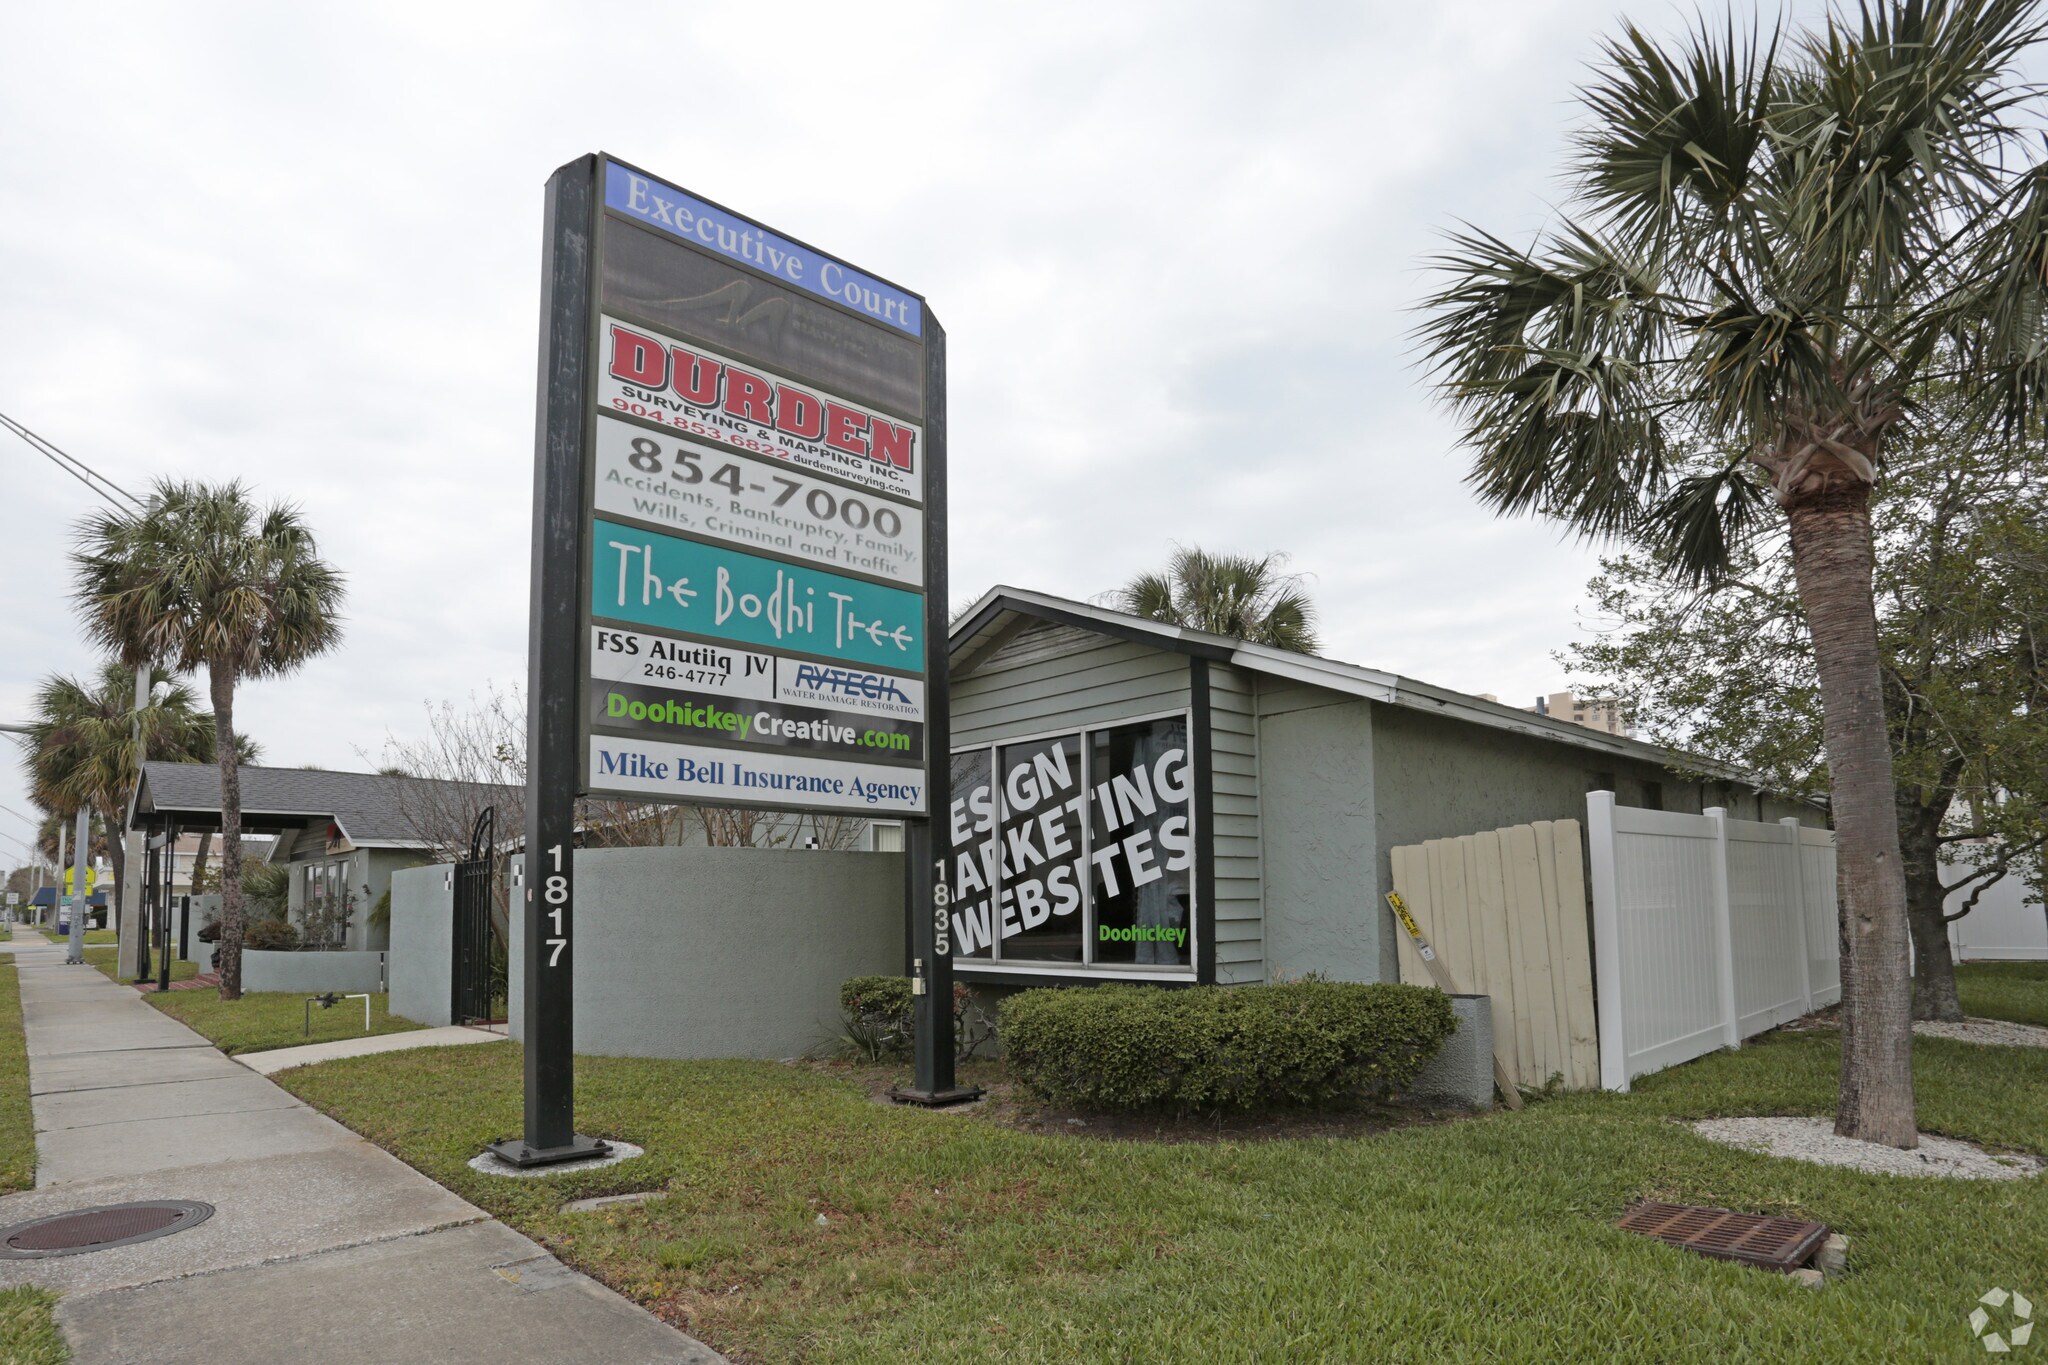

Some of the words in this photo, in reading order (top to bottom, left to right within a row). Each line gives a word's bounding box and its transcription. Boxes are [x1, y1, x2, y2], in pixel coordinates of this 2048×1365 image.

[626, 172, 803, 280] Executive
[820, 262, 908, 326] Court
[608, 323, 916, 475] DURDEN
[612, 397, 790, 461] 904.853.6822
[793, 454, 911, 496] durdensurveying.com
[621, 385, 748, 434] SURVEYING
[756, 429, 771, 442] &
[779, 436, 863, 469] MAPPING
[869, 463, 904, 483] INC.
[604, 468, 722, 511] Accidents,
[729, 500, 849, 545] Bankruptcy,
[855, 534, 918, 562] Family,
[628, 437, 902, 538] 854-7000
[632, 497, 696, 528] Wills,
[705, 516, 792, 548] Criminal
[799, 541, 837, 560] and
[843, 549, 899, 575] Traffic
[608, 540, 698, 608] The
[714, 566, 815, 640] Bodhi
[827, 591, 914, 651] Tree
[597, 631, 640, 656] FSS
[649, 640, 732, 675] Alutiiq
[744, 655, 769, 677] JV
[643, 663, 728, 687] 246-4777
[782, 687, 815, 700] WATER
[818, 693, 858, 706] DAMAGE
[860, 699, 919, 715] RESTORATION
[795, 663, 900, 702] RYTECH
[607, 692, 911, 751] DoohickeyCreative.com
[598, 749, 669, 780] Mike
[676, 757, 725, 785] Bell
[731, 763, 844, 795] Insurance
[848, 775, 921, 806] Agency
[951, 741, 1073, 847] ESGN
[951, 748, 1190, 903] ARKETING
[544, 844, 568, 967] 1817
[934, 858, 950, 956] 1835
[1099, 923, 1187, 948] Doohickey
